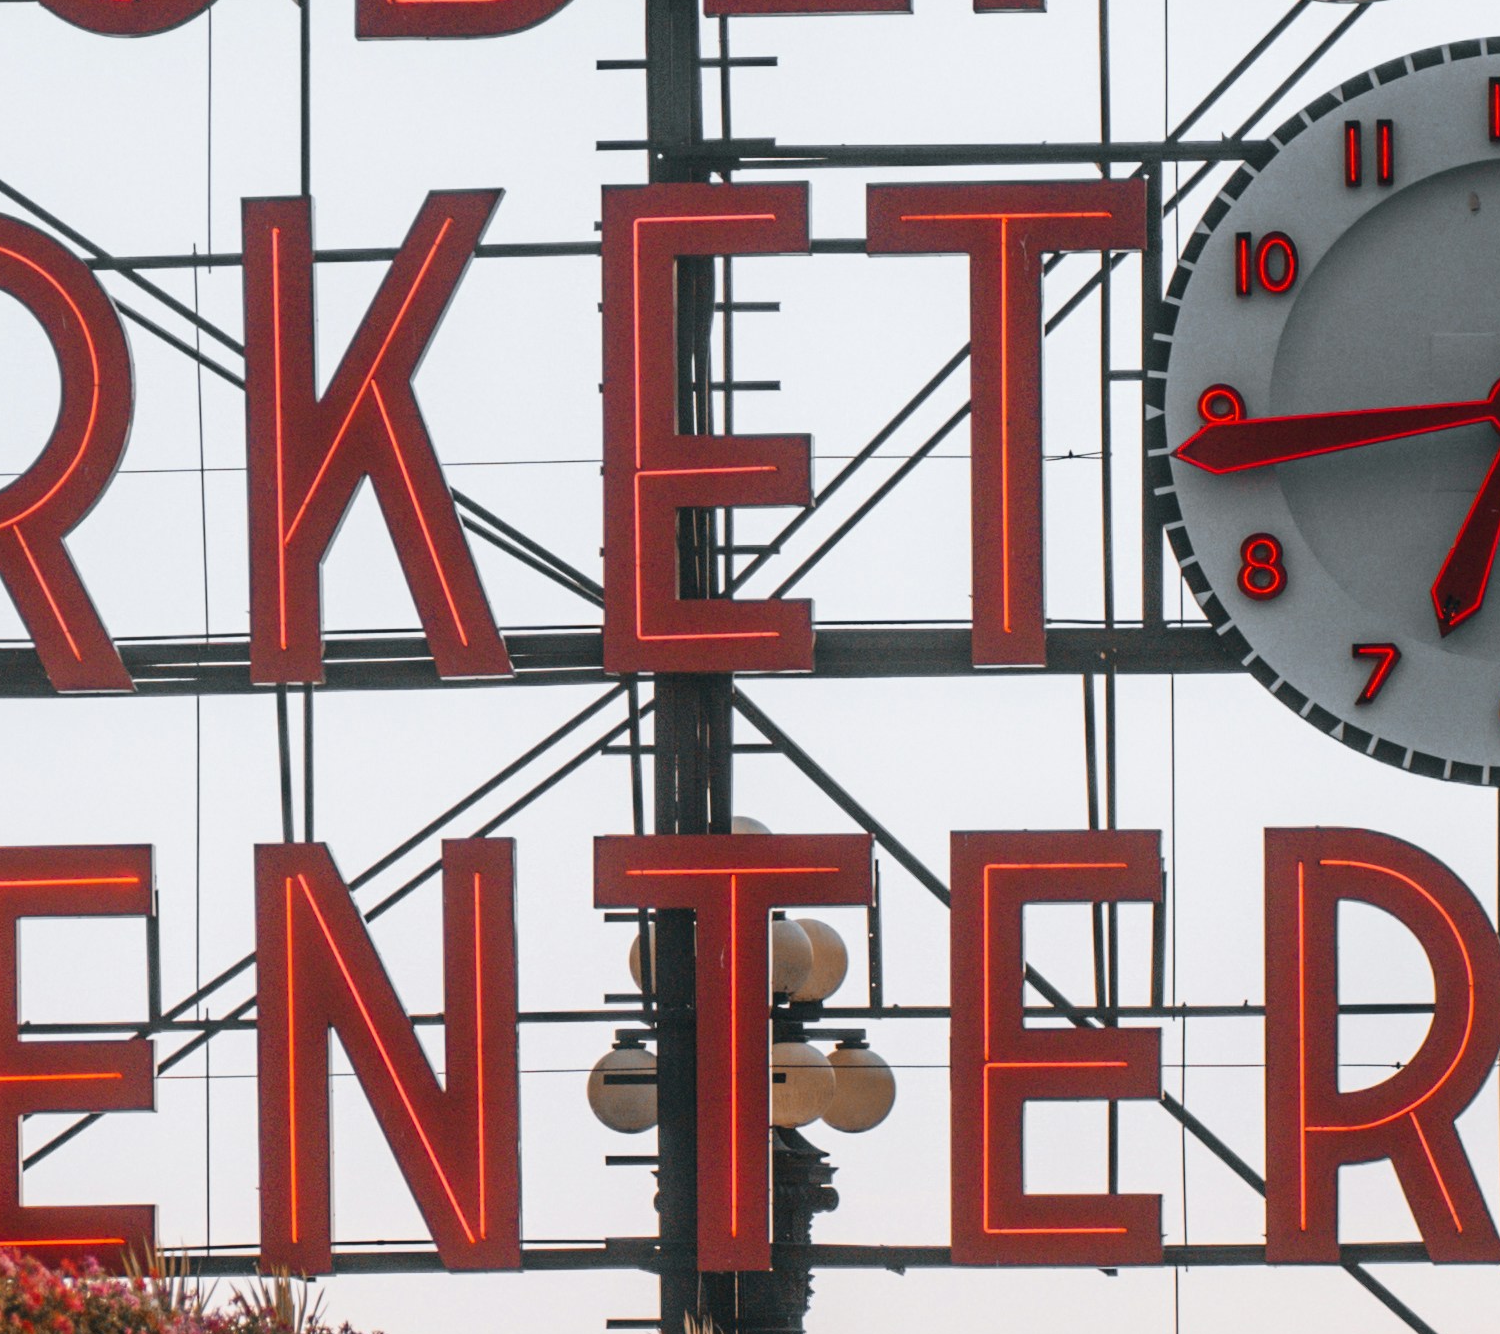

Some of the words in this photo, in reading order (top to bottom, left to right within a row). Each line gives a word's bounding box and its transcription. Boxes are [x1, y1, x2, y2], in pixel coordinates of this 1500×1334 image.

[1344, 119, 1394, 187] 11
[1235, 231, 1299, 297] 10
[1237, 532, 1288, 601] 8
[1351, 641, 1400, 706] 7
